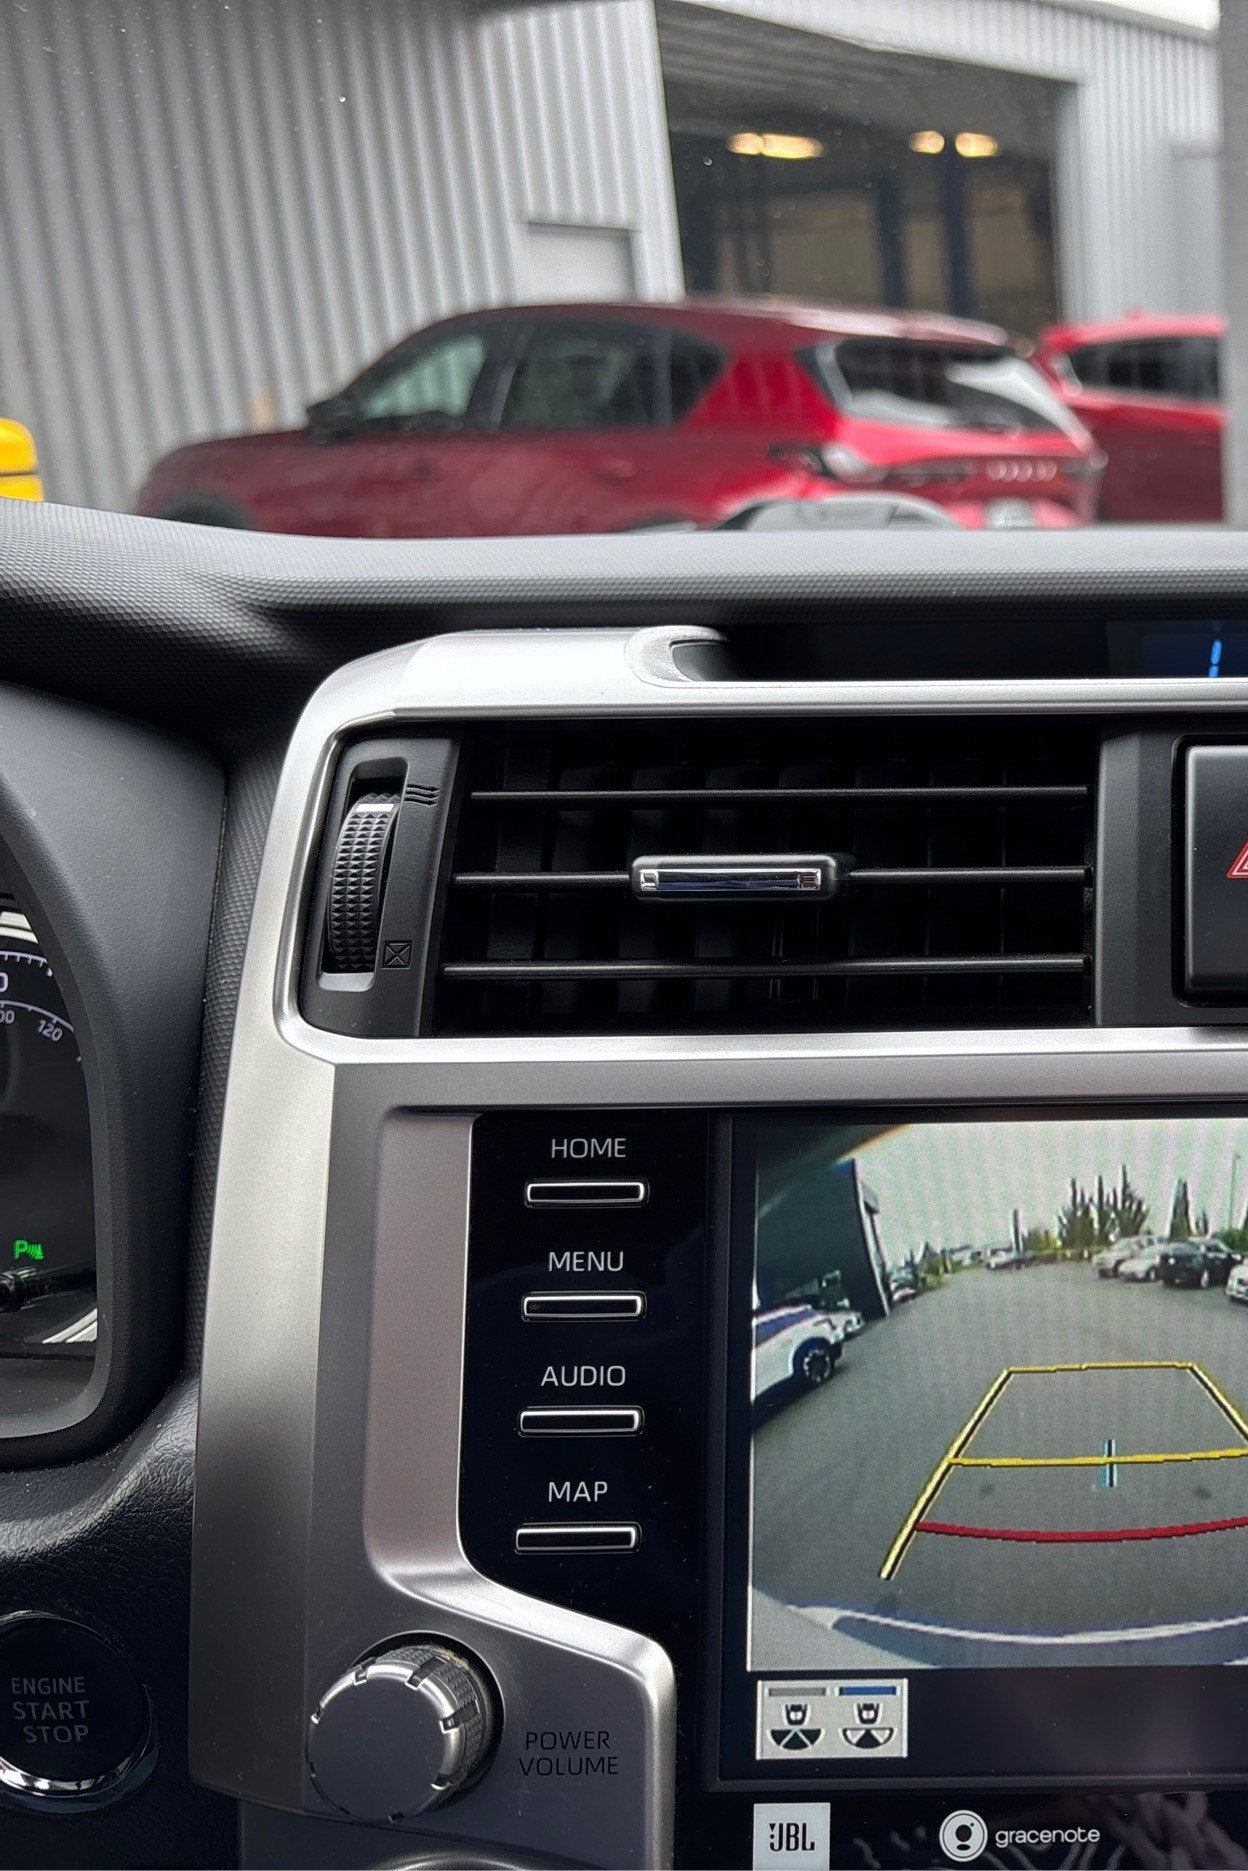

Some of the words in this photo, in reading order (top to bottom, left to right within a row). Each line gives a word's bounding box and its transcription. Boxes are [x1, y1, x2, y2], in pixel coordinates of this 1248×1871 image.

[38, 1019, 63, 1042] 120
[551, 1138, 627, 1158] HOME
[548, 1251, 624, 1272] MENU
[540, 1365, 627, 1387] AUDIO
[548, 1481, 608, 1503] MAP
[11, 1676, 86, 1695] ENGINE
[12, 1700, 90, 1720] START
[23, 1724, 89, 1743] STOP
[525, 1731, 611, 1750] POWER
[518, 1756, 619, 1776] VOLUME
[768, 1822, 816, 1852] JBL
[995, 1827, 1101, 1848] gracenote
